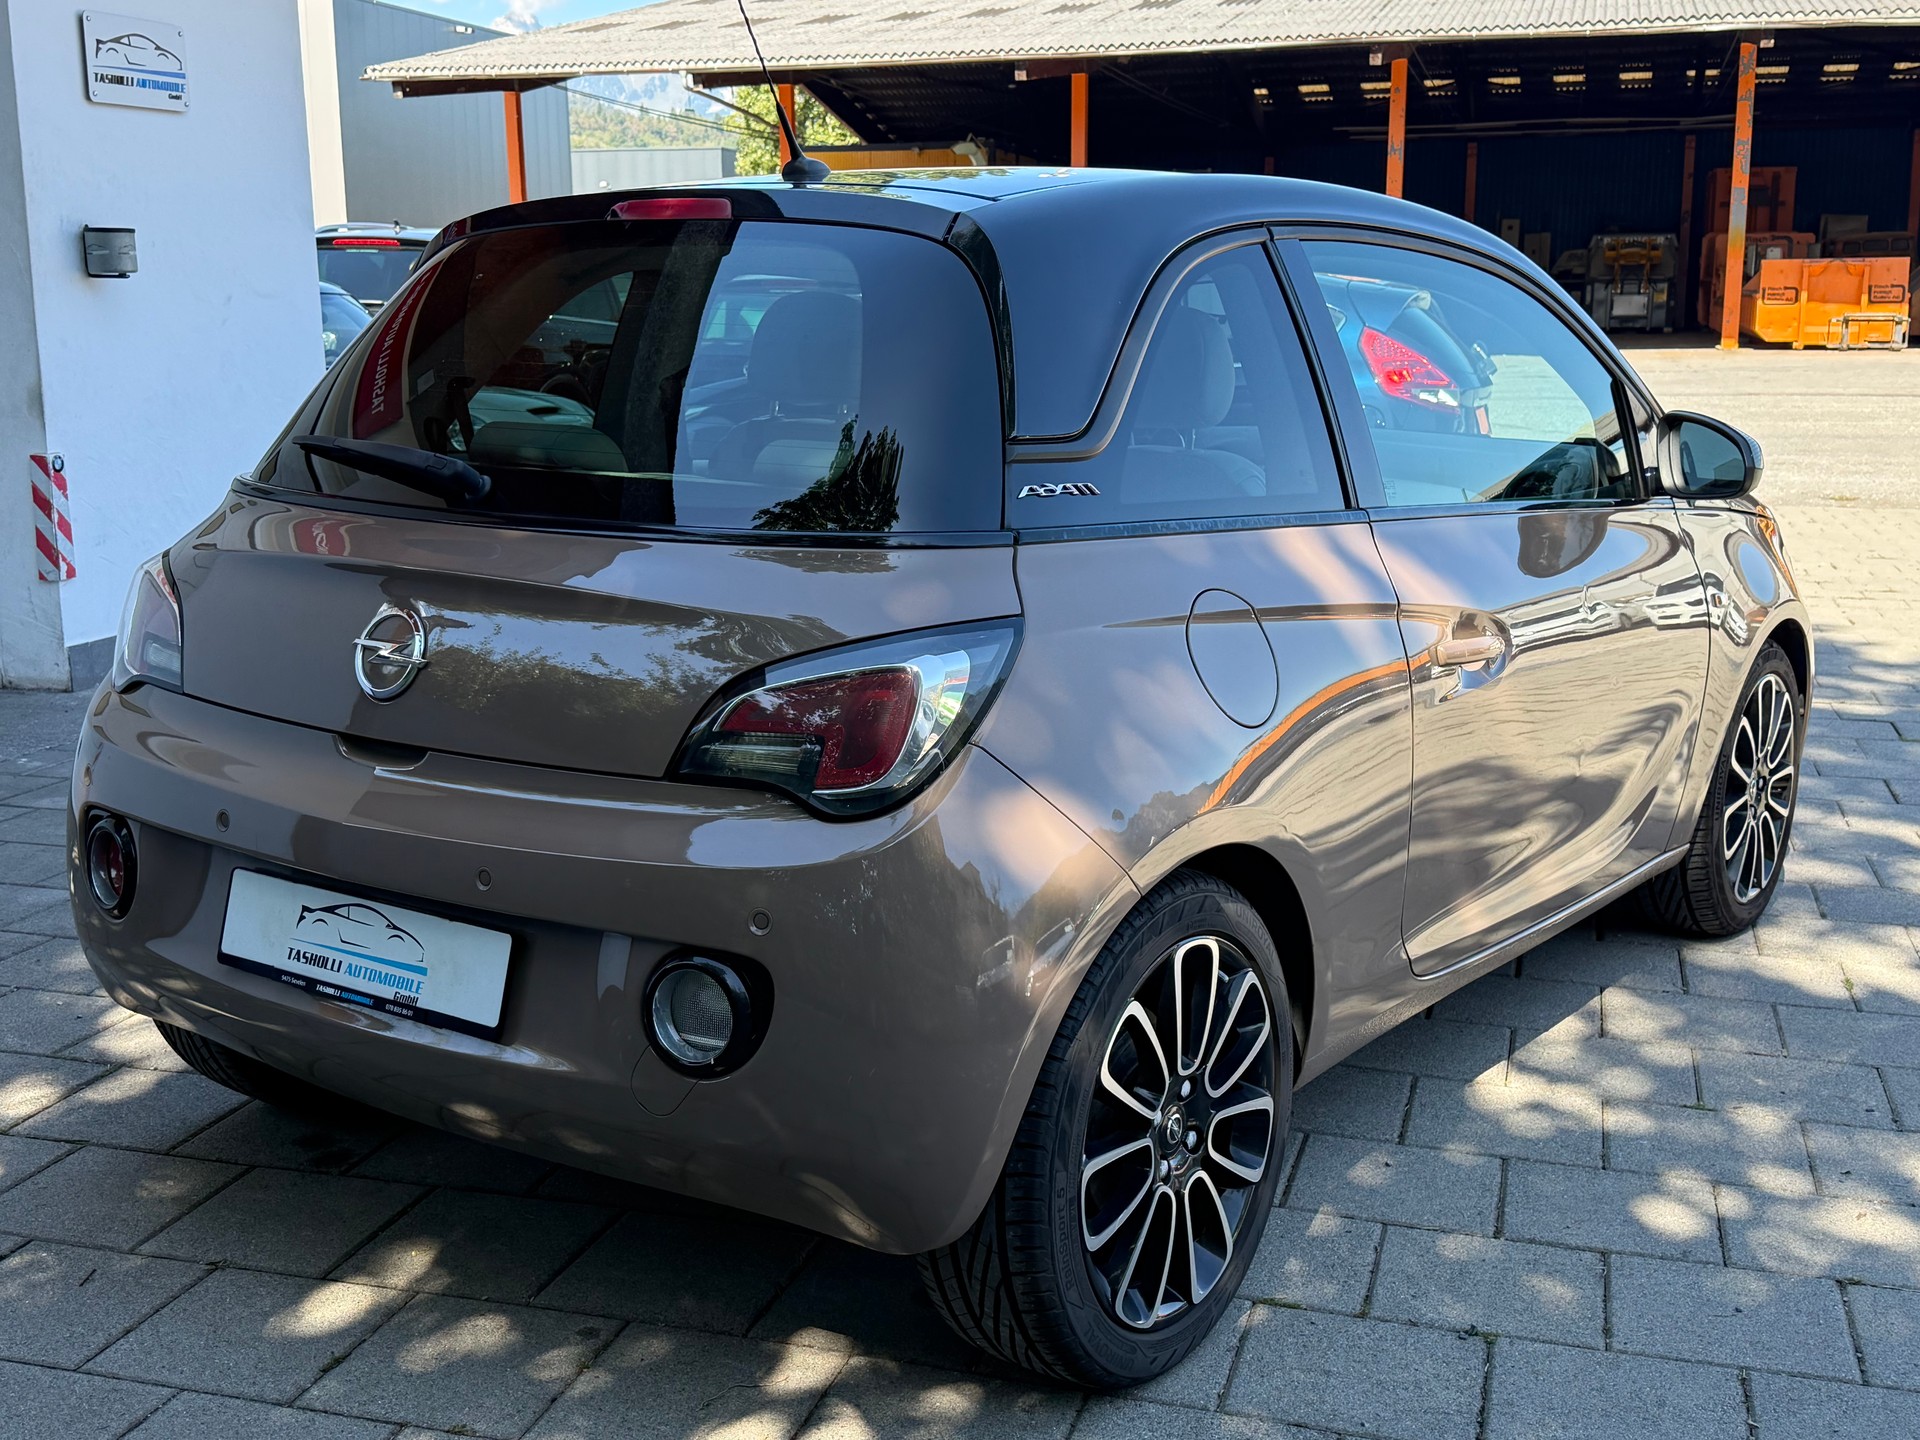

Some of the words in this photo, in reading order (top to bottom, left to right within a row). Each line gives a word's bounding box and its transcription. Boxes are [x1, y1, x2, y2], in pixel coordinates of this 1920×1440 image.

[93, 72, 134, 87] TASHOLLI
[135, 77, 186, 94] AUTOMOBILE
[1018, 483, 1100, 498] ADAM
[287, 946, 343, 973] TASHOLLI
[343, 962, 425, 995] AUTOMOBILE
[316, 983, 340, 997] TASHOLLI
[340, 991, 375, 1007] AUTOMOBILE
[393, 991, 419, 1007] GmbH
